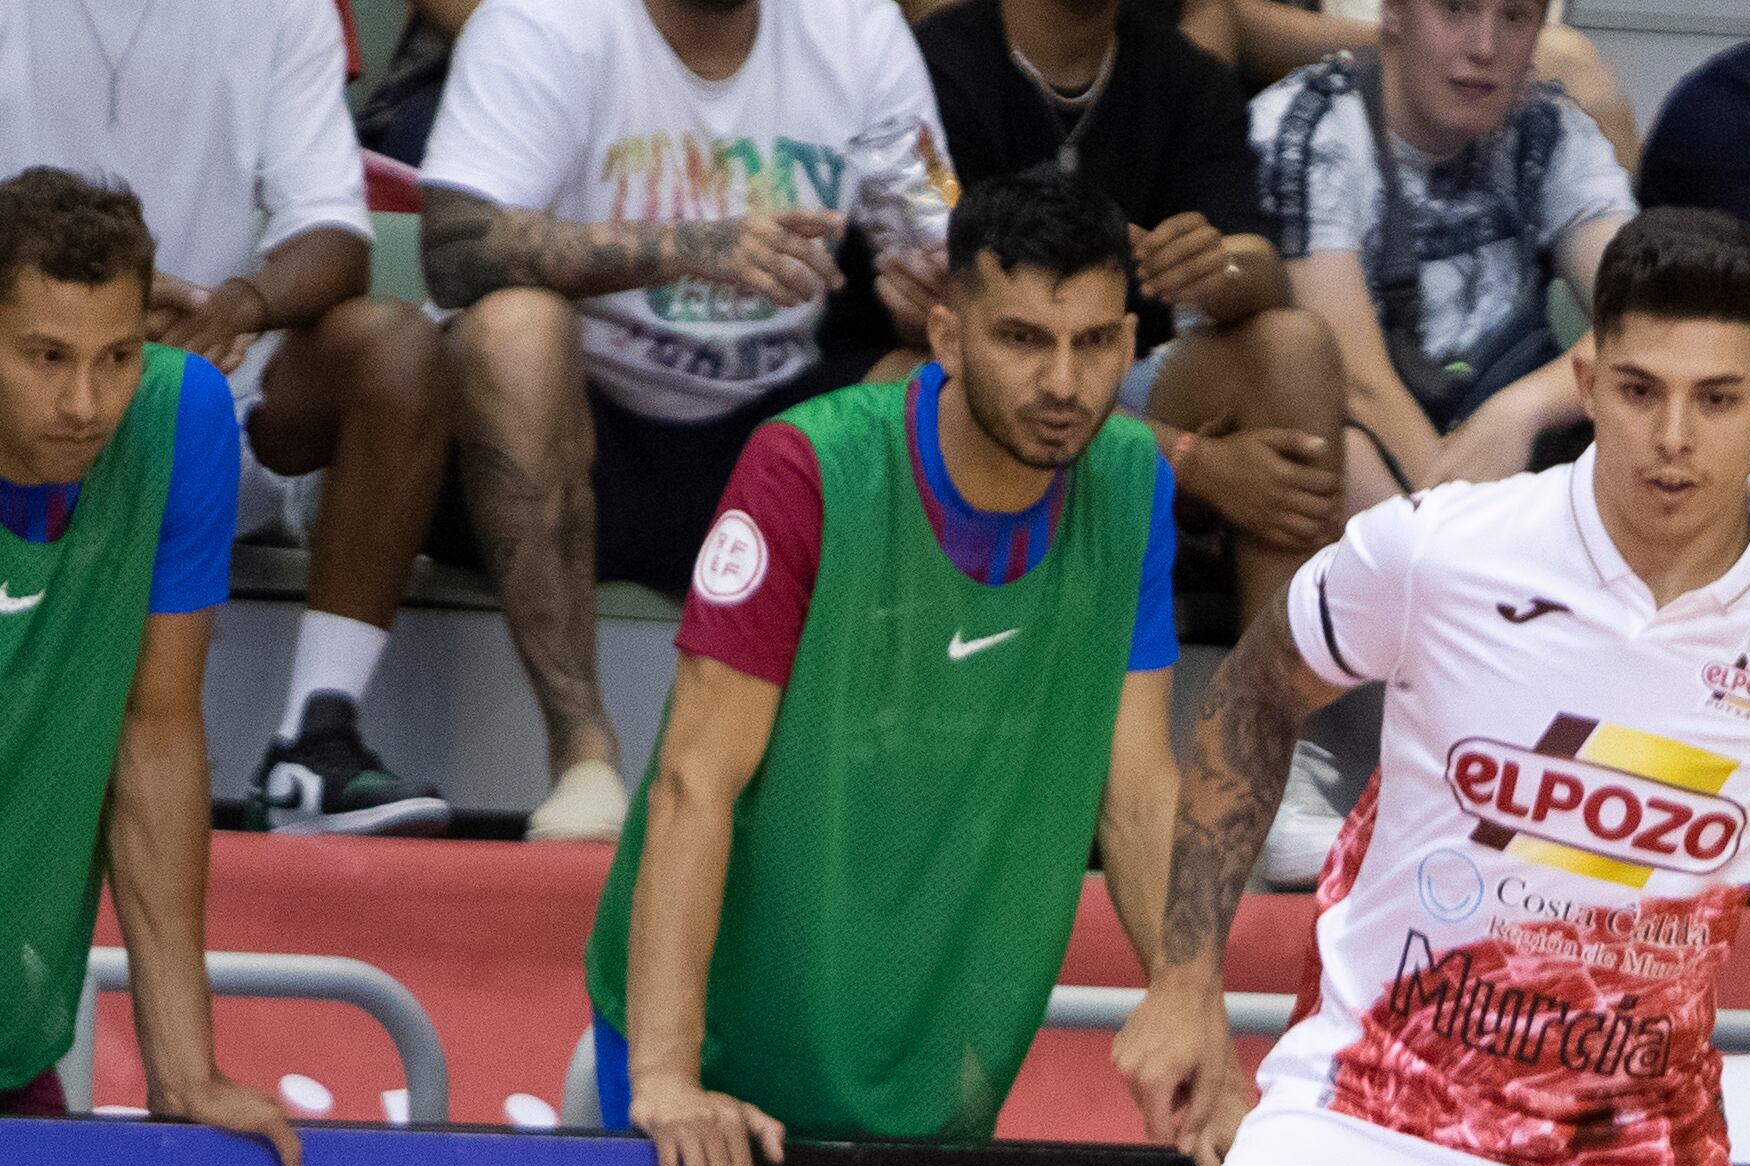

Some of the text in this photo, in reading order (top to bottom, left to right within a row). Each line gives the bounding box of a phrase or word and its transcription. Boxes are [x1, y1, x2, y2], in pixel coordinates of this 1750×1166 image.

[1495, 876, 1596, 929] Costa
[1583, 943, 1617, 969] de
[1389, 927, 1673, 1080] Murcia
